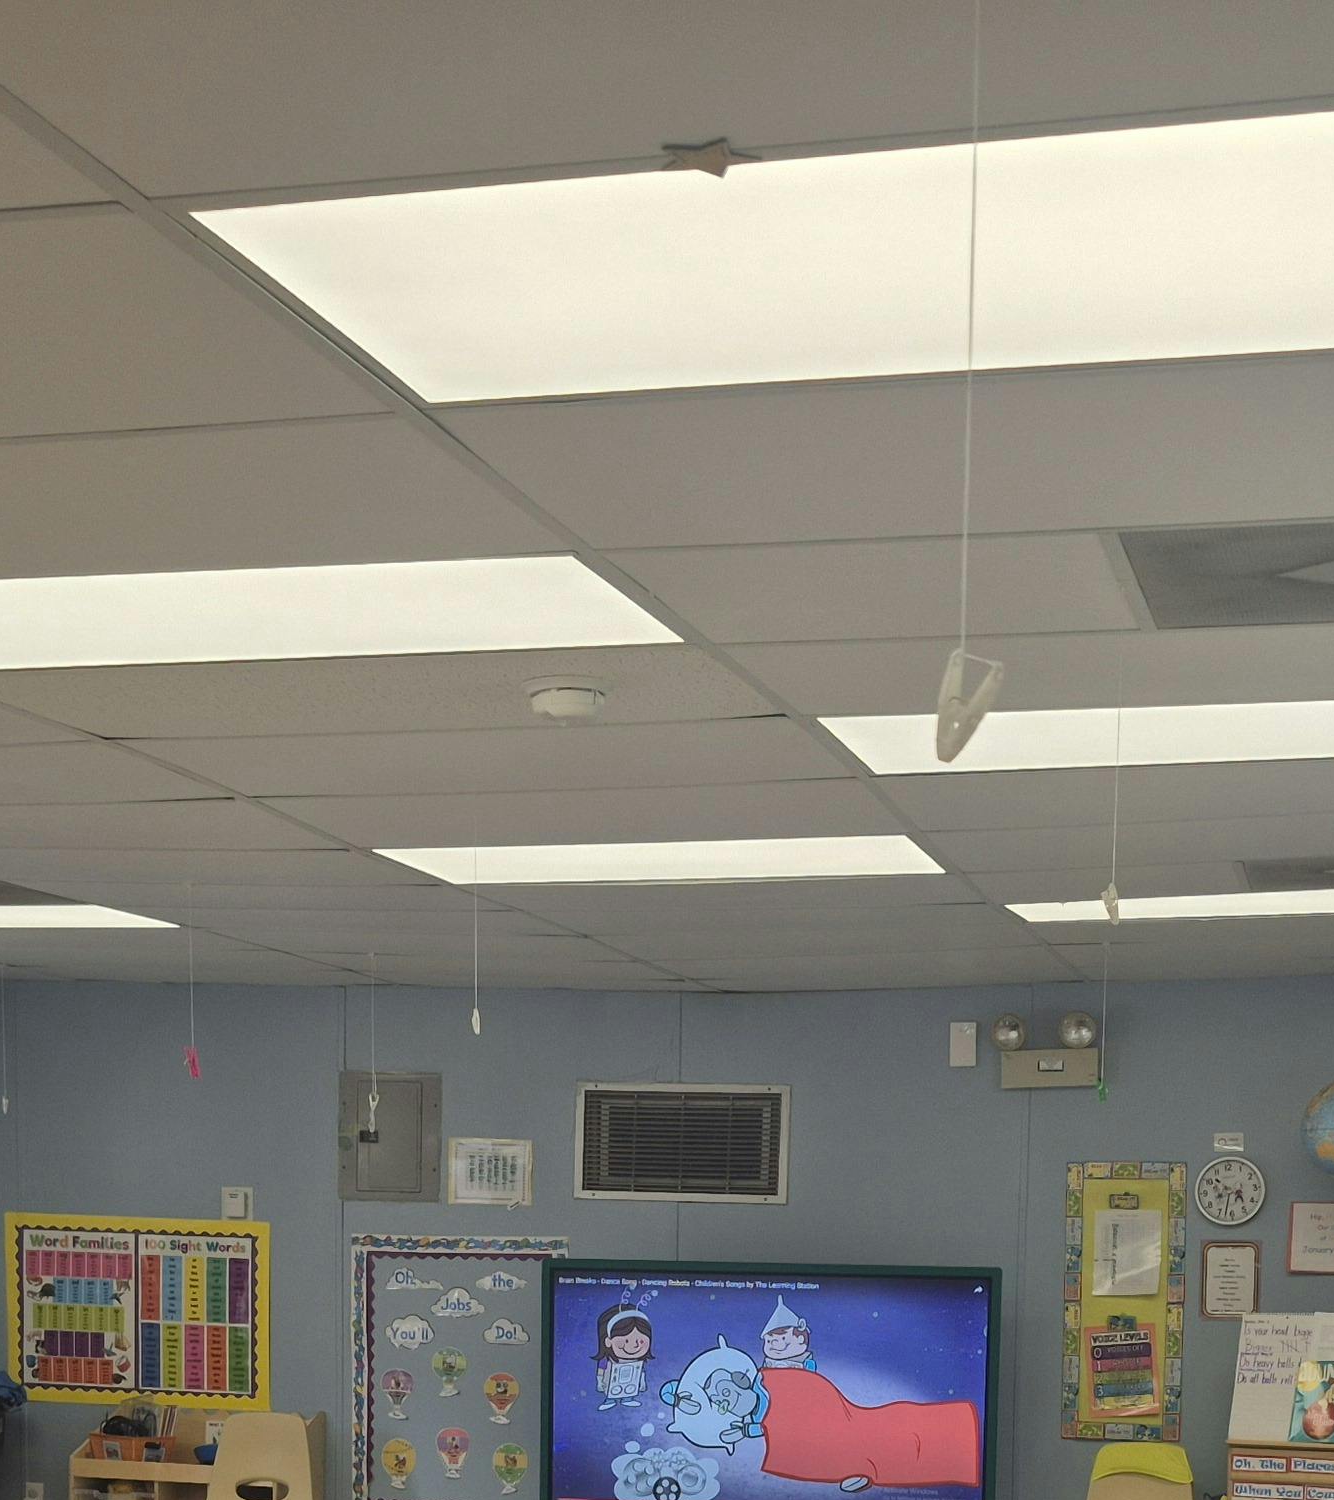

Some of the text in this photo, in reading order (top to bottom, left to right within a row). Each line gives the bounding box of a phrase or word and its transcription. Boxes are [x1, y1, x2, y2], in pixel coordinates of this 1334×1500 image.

[30, 1234, 130, 1250] Word Families
[145, 1238, 246, 1254] 100 Sight Words
[1302, 1245, 1333, 1254] January
[491, 1275, 514, 1288] the
[441, 1298, 472, 1312] Jobs
[391, 1328, 429, 1341] You'll
[495, 1327, 517, 1340] Do!
[1092, 1334, 1118, 1343] VOICE
[1235, 1485, 1272, 1497] When
[1276, 1487, 1301, 1498] You
